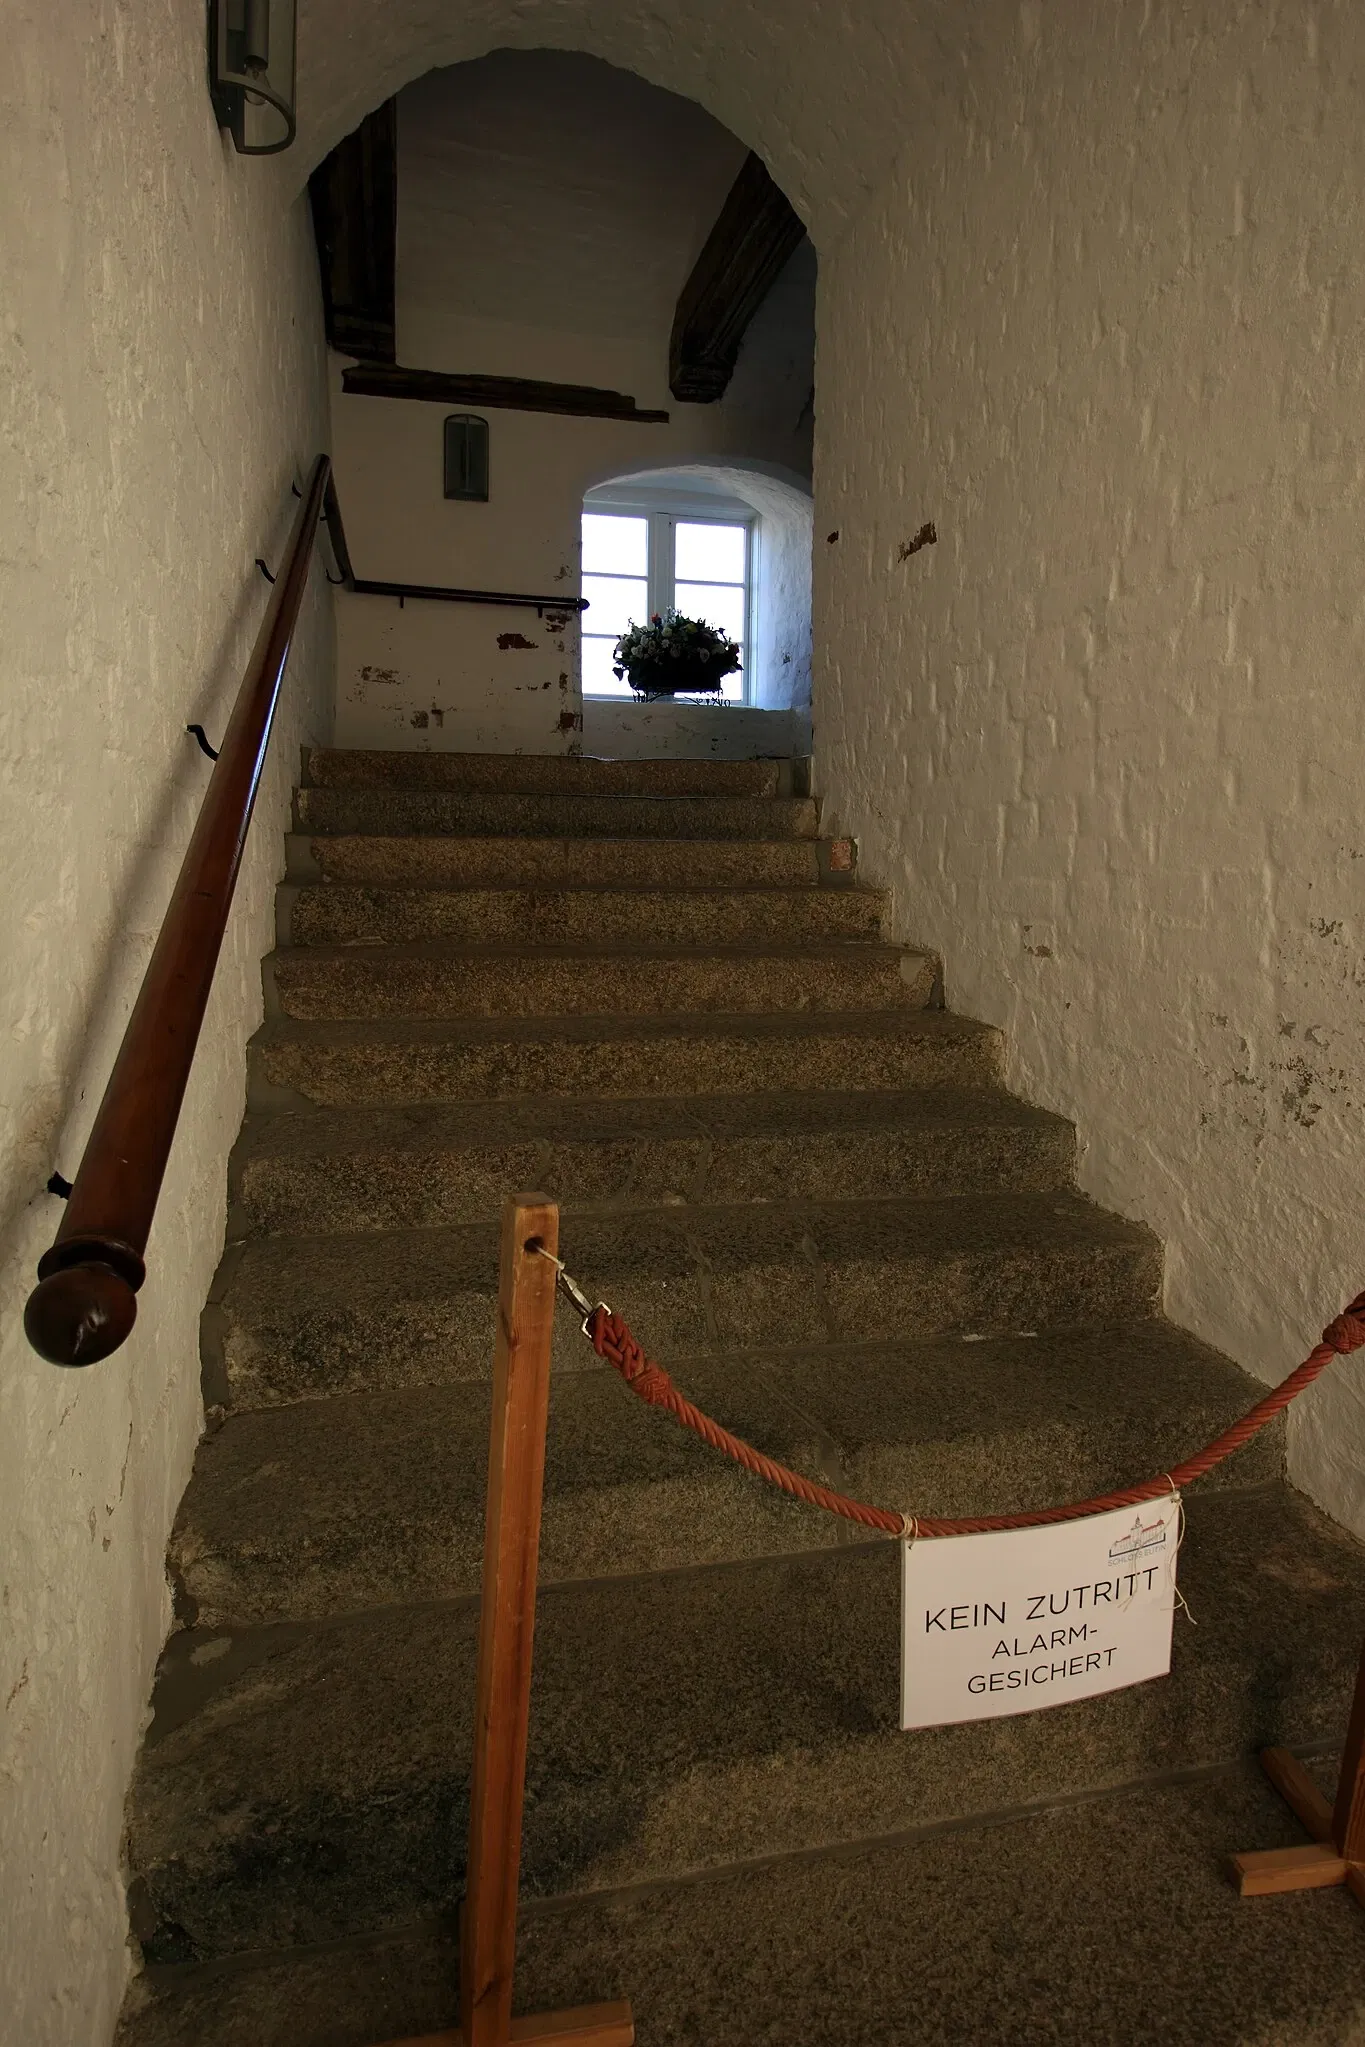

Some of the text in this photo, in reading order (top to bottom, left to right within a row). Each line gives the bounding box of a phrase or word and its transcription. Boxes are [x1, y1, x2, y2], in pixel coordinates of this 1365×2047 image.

[925, 1566, 1159, 1633] KEIN ZUTRITT
[991, 1623, 1098, 1659] ALARM-
[967, 1647, 1117, 1694] GESICHERT
